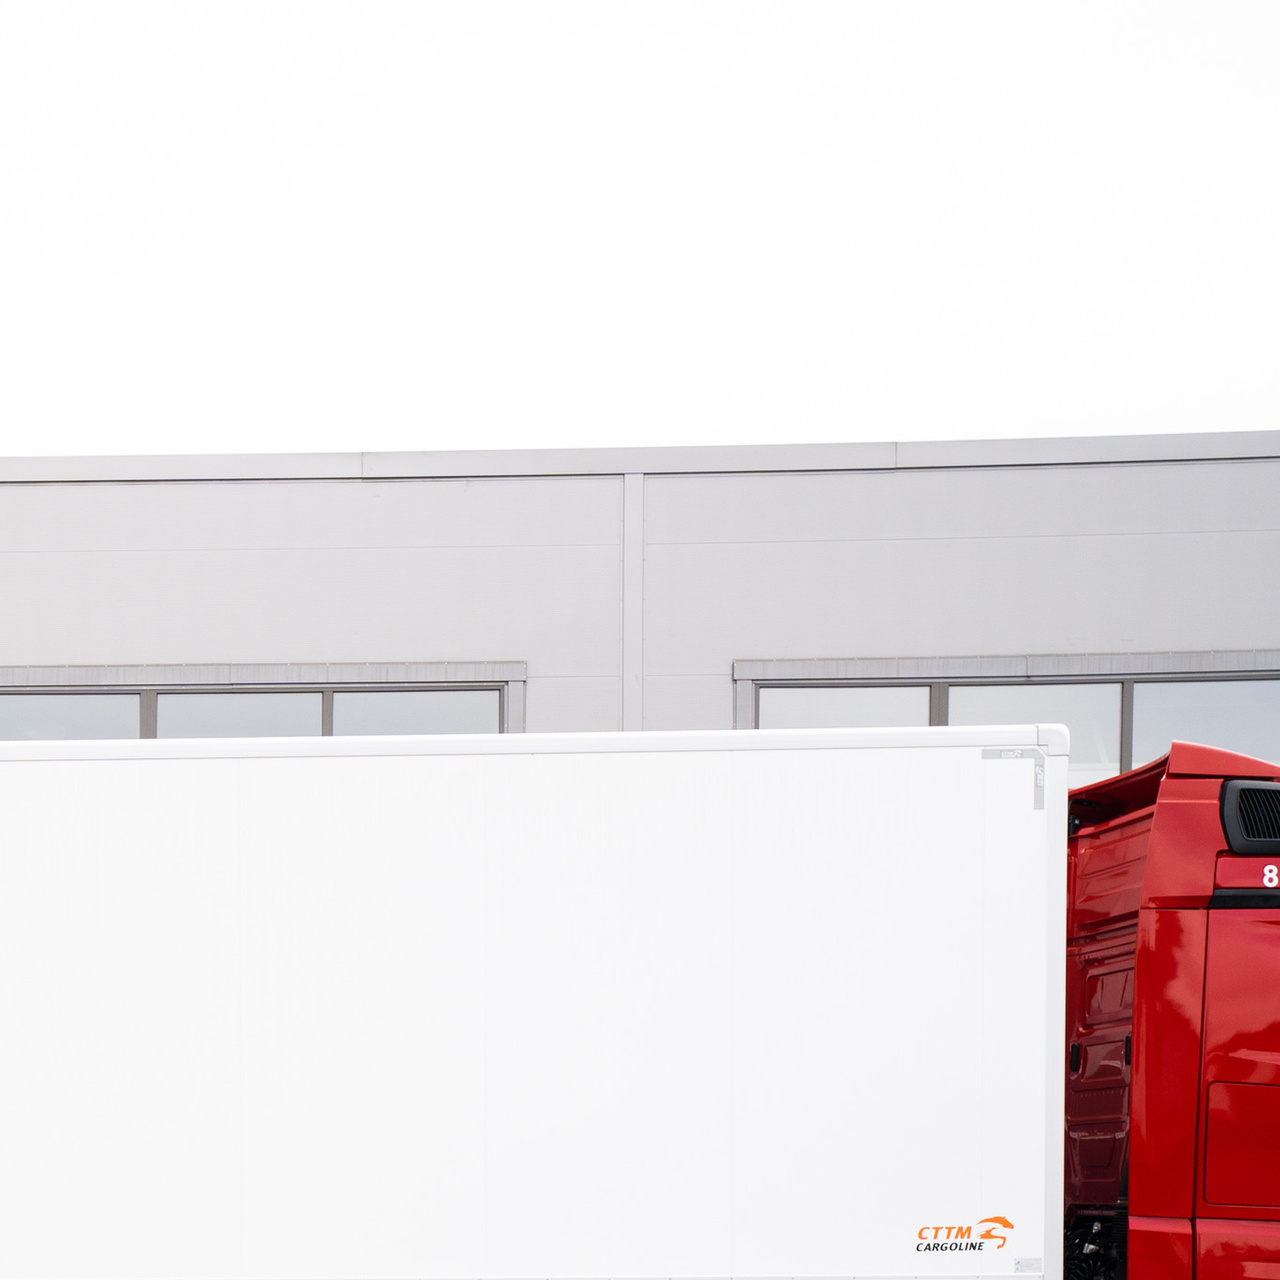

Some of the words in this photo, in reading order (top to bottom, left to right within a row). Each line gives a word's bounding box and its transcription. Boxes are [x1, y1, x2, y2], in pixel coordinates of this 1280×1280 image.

[1262, 864, 1279, 888] 8
[917, 1226, 972, 1240] CTTM
[916, 1242, 984, 1252] CARGOLINE
